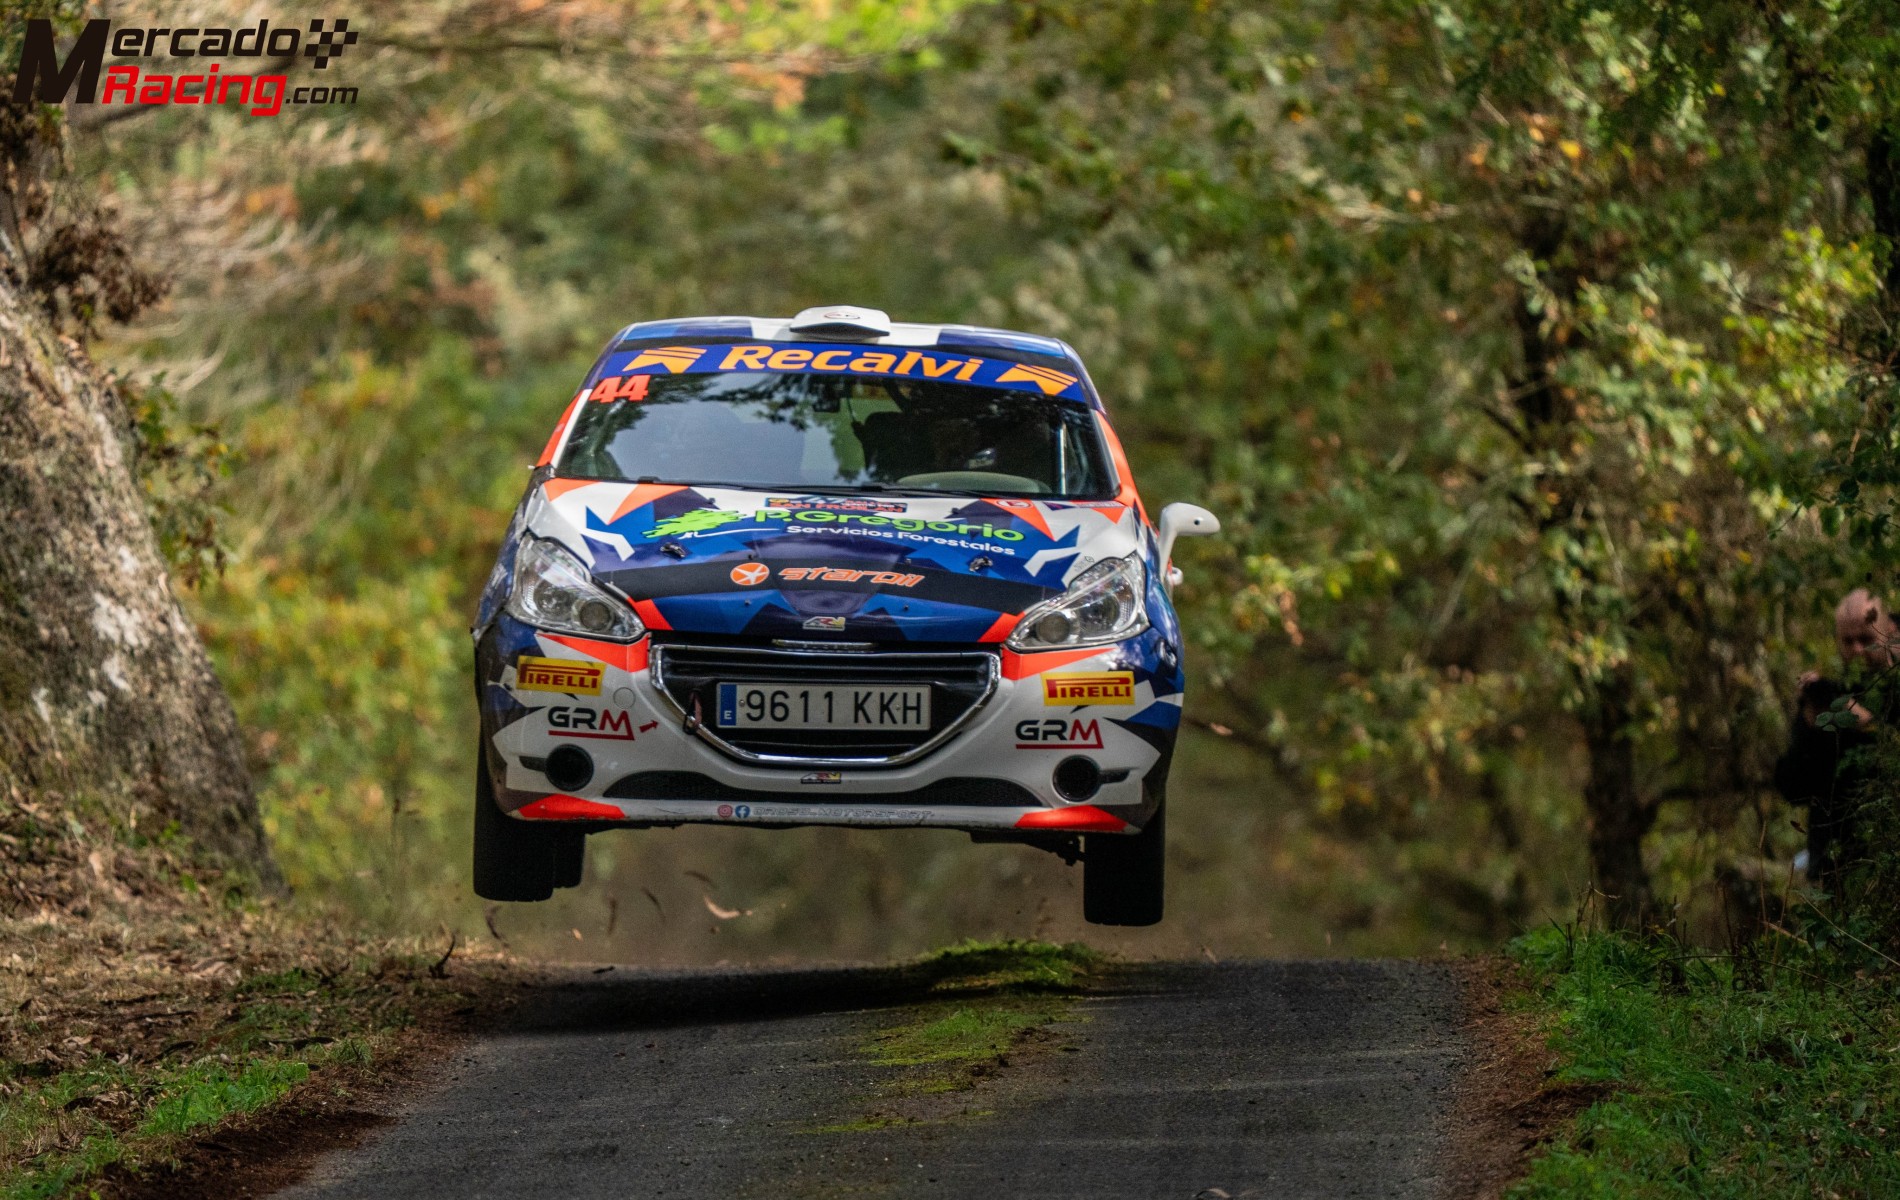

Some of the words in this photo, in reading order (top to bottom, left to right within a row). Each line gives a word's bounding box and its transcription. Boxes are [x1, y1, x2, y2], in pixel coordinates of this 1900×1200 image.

[718, 345, 984, 381] Recalvi
[589, 374, 650, 403] 44
[755, 510, 1025, 542] P.Gregorio
[787, 525, 893, 538] Servicios
[897, 531, 1015, 556] Forestales
[519, 663, 600, 688] PIRELLI
[1046, 677, 1130, 698] PIRELLI
[548, 706, 635, 740] GRM
[724, 711, 732, 720] E
[746, 690, 834, 723] 9611
[853, 691, 922, 725] KKH
[1015, 718, 1104, 749] GRM
